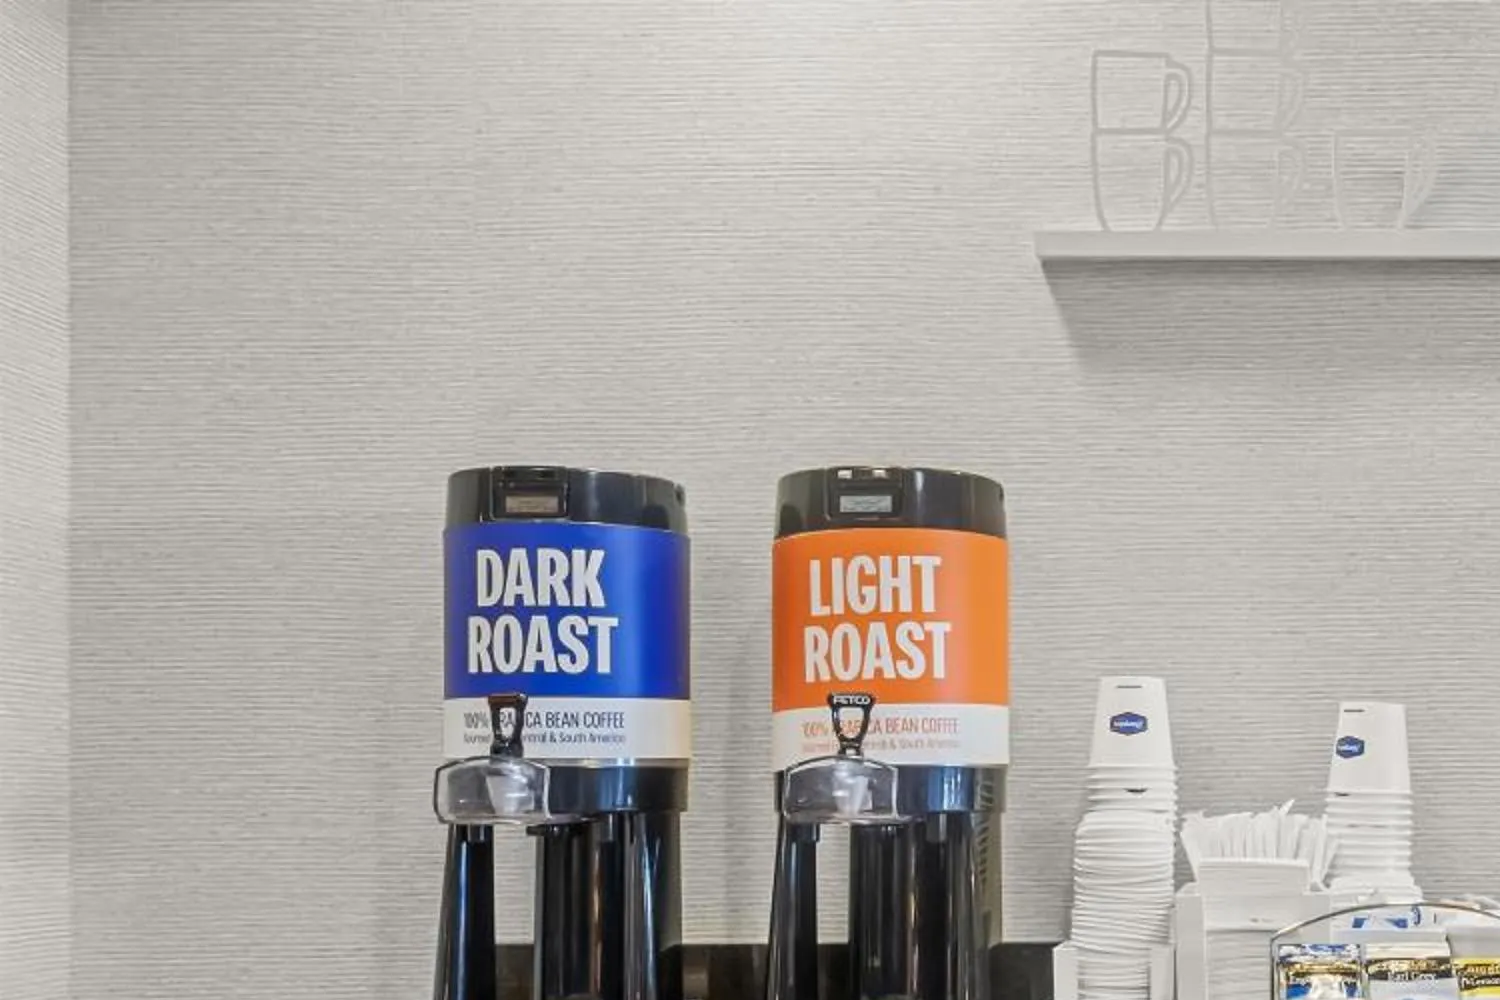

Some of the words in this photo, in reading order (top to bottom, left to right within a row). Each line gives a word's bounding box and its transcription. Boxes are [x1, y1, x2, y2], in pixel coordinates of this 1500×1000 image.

[477, 547, 606, 608] DARK
[809, 555, 942, 616] LIGHT
[467, 614, 619, 674] ROAST
[803, 620, 952, 683] ROAST
[545, 711, 579, 729] BEAN
[583, 711, 625, 729] COFFEE
[885, 717, 919, 734] BEAN
